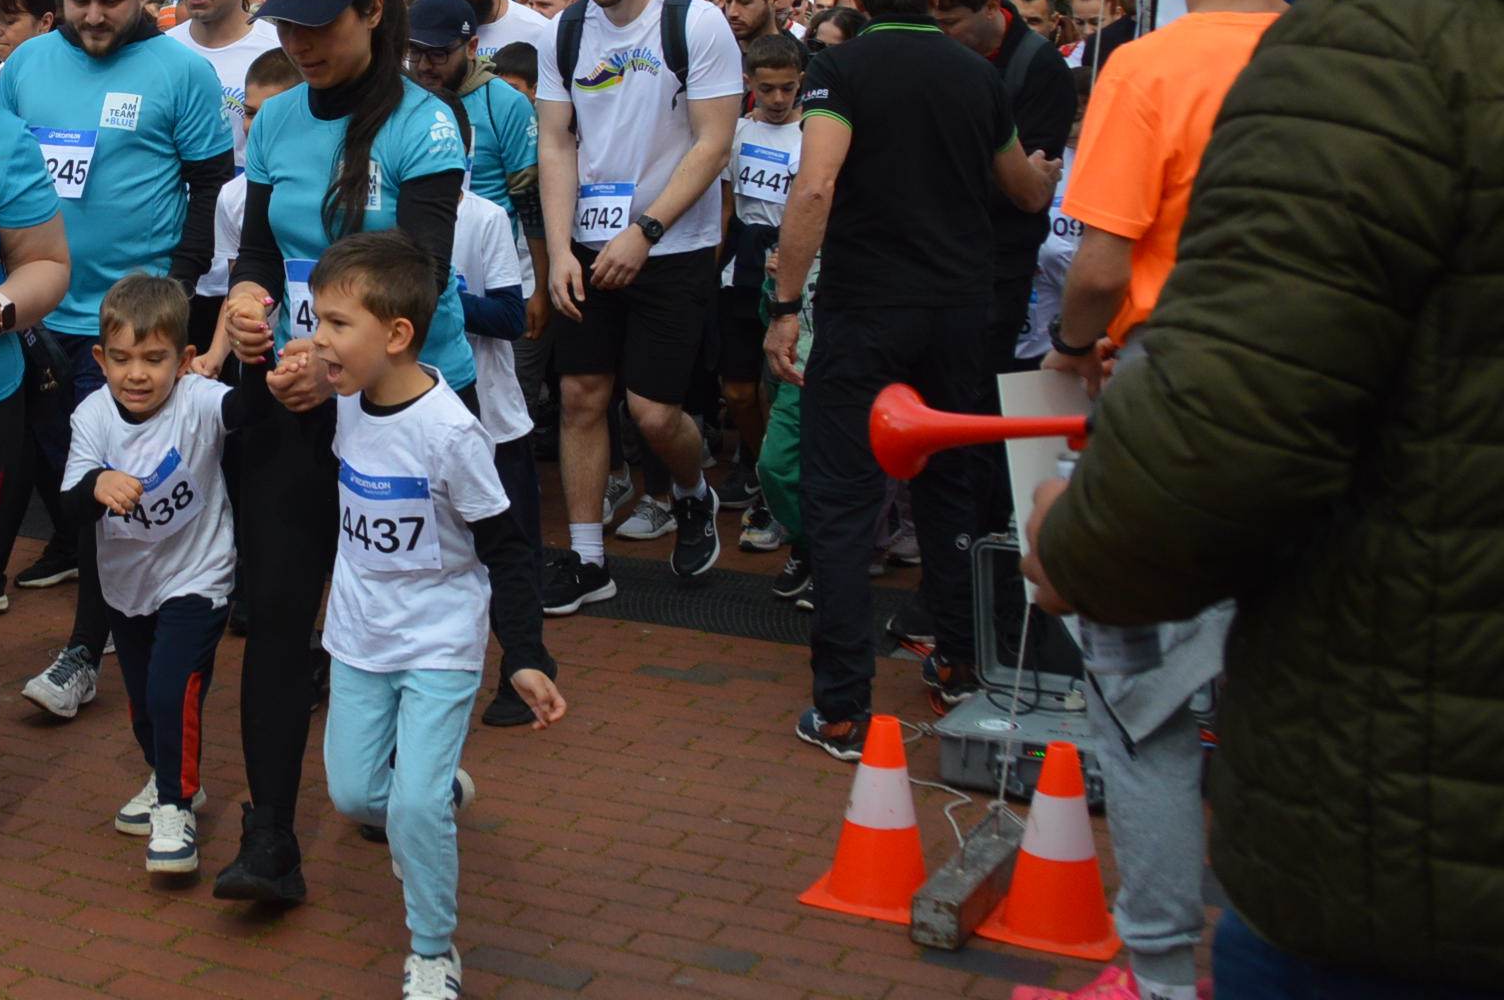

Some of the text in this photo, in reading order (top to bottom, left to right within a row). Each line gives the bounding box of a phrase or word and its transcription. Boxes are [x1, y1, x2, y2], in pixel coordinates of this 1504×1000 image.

[610, 47, 662, 70] Marathon
[631, 59, 659, 77] Varna
[109, 108, 136, 119] TEAM
[121, 102, 137, 111] AM
[47, 158, 88, 185] 245
[739, 166, 790, 195] 4441
[580, 206, 623, 231] 4742
[1052, 217, 1085, 237] 09
[343, 506, 425, 554] 4437
